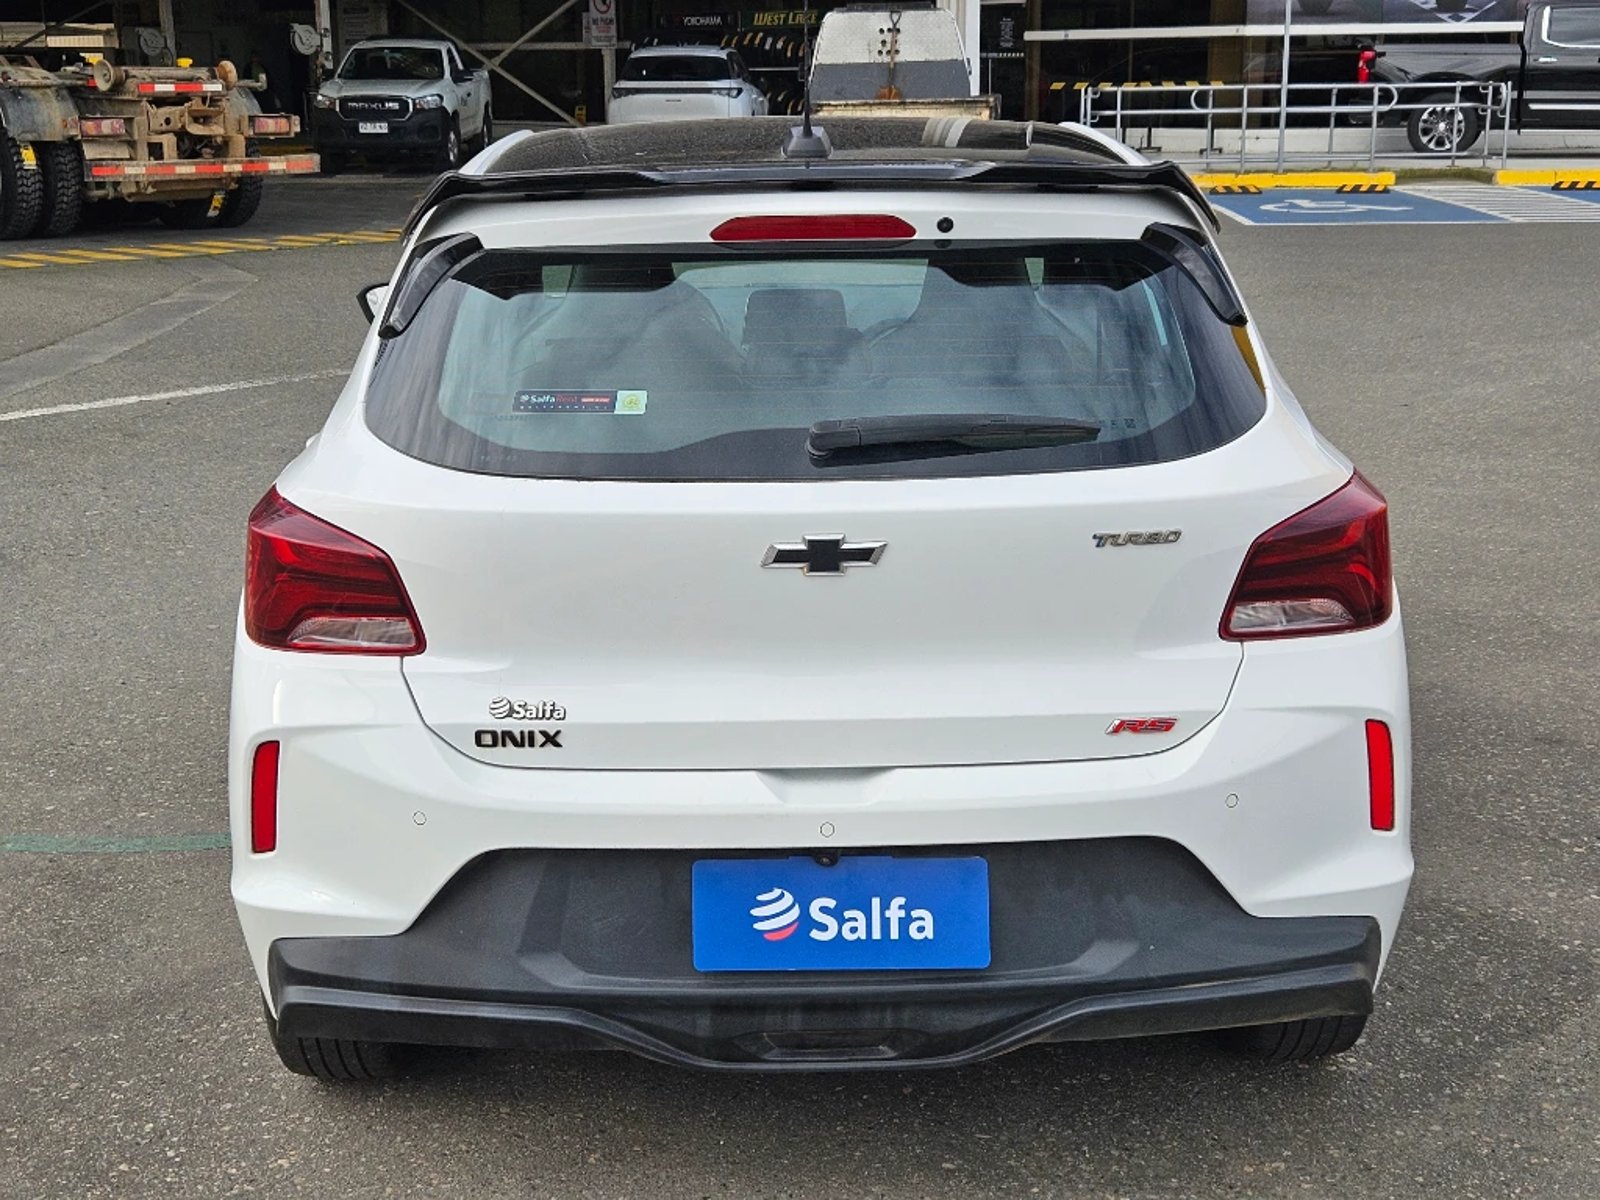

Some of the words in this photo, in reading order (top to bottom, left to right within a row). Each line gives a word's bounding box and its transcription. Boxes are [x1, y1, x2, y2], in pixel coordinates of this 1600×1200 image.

[682, 15, 722, 26] YOKOHAMA
[753, 12, 786, 26] WEST
[347, 102, 399, 110] MAXUS
[1092, 529, 1182, 548] TURBO
[511, 699, 566, 720] Salfa
[1105, 717, 1177, 735] RS
[474, 729, 563, 748] ONIX
[809, 895, 934, 942] Salfa
